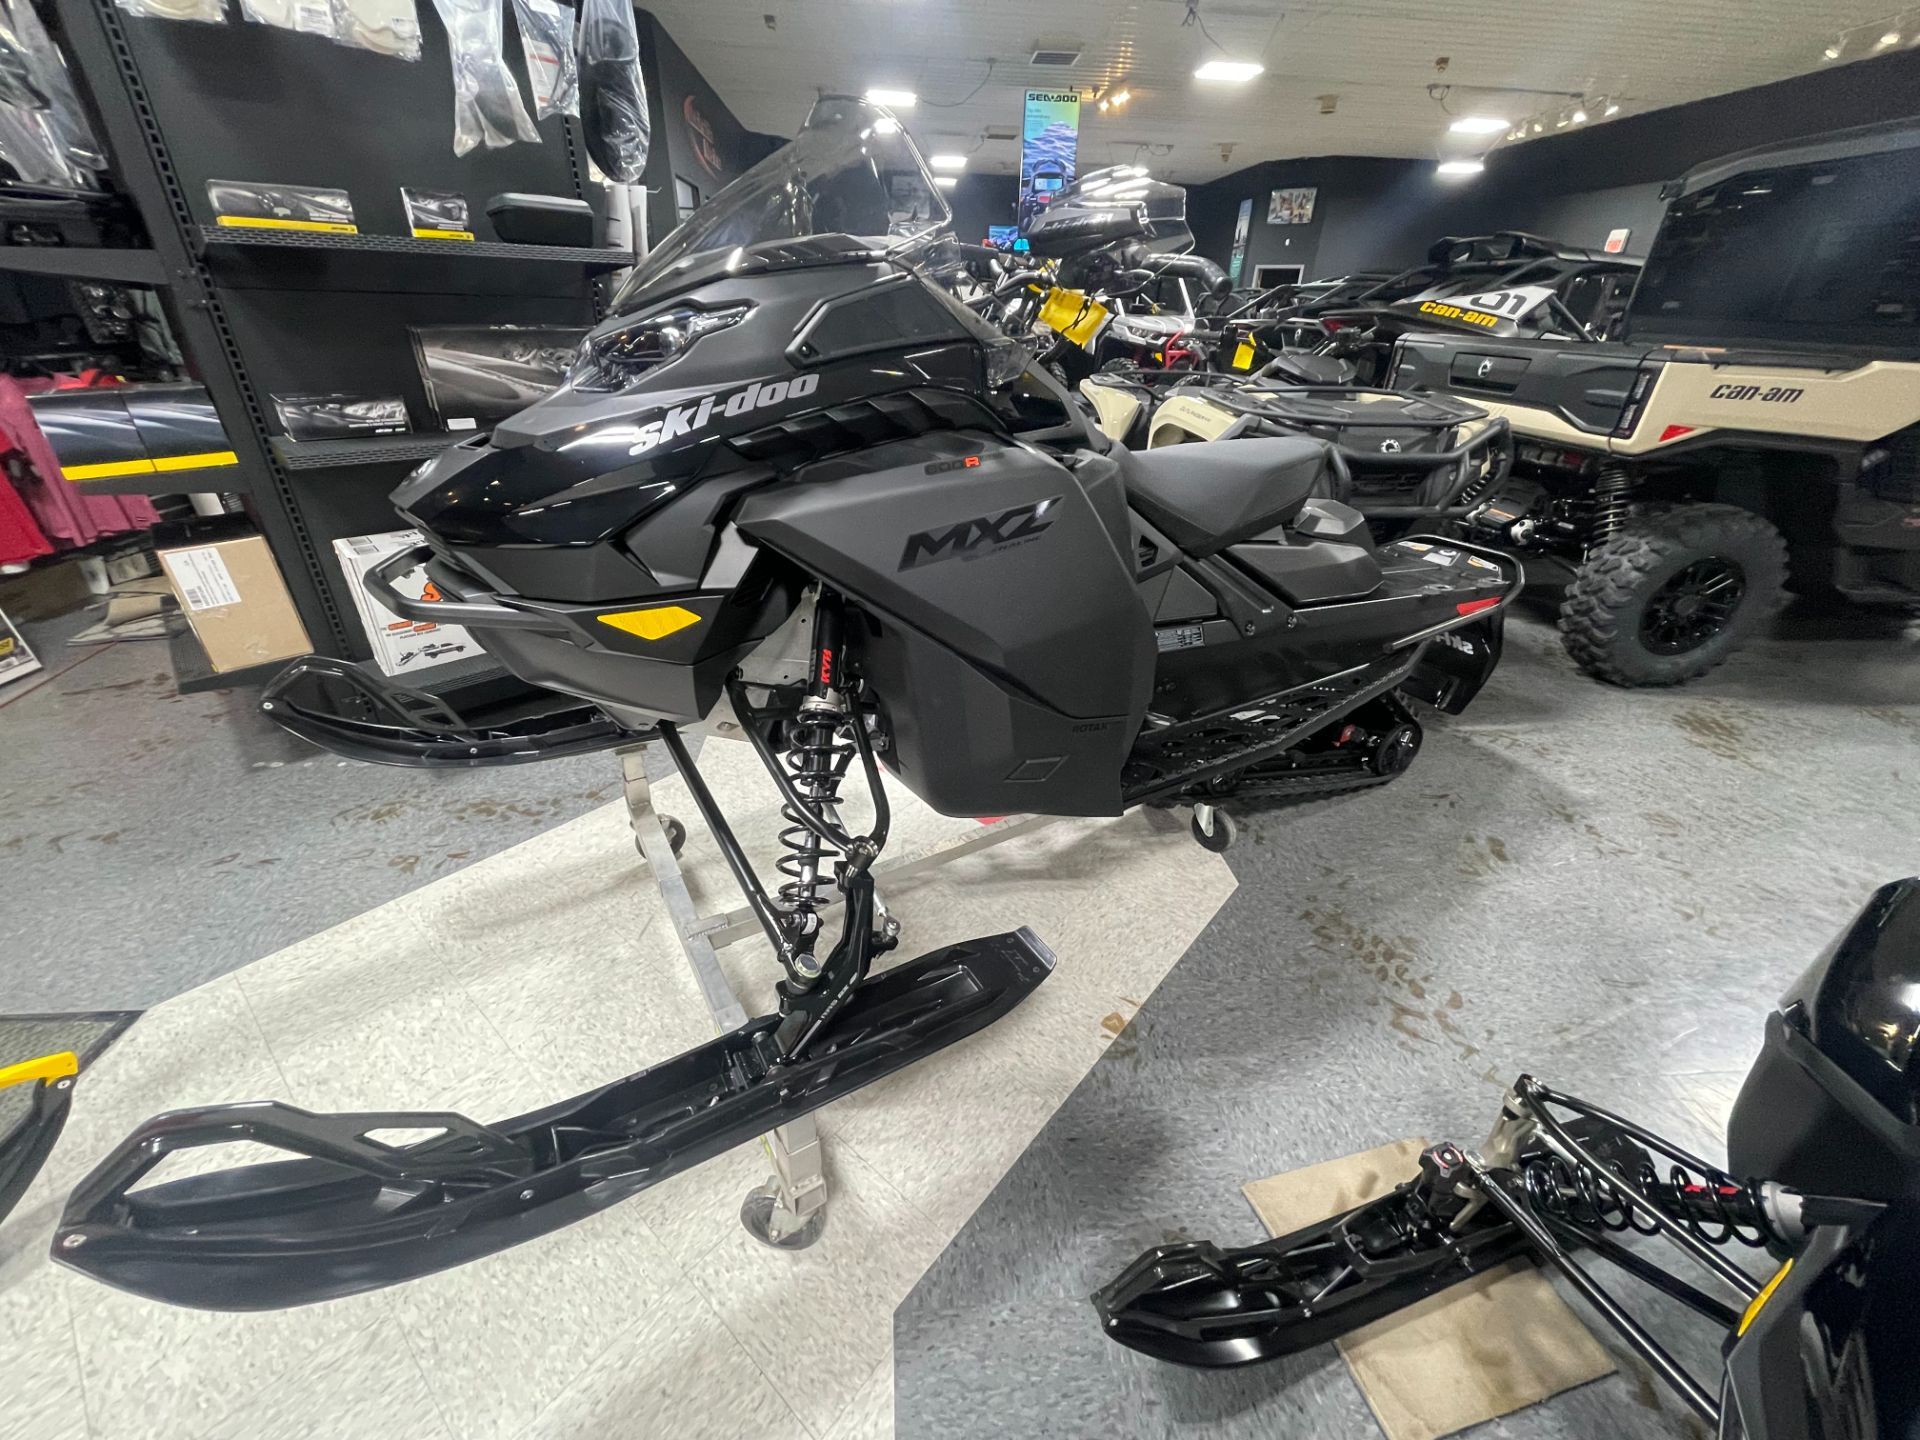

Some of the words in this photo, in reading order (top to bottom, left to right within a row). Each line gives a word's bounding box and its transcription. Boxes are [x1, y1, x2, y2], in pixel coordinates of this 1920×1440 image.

[1419, 301, 1499, 328] can-am
[1709, 384, 1805, 403] can-am
[897, 494, 1065, 573] MXZ
